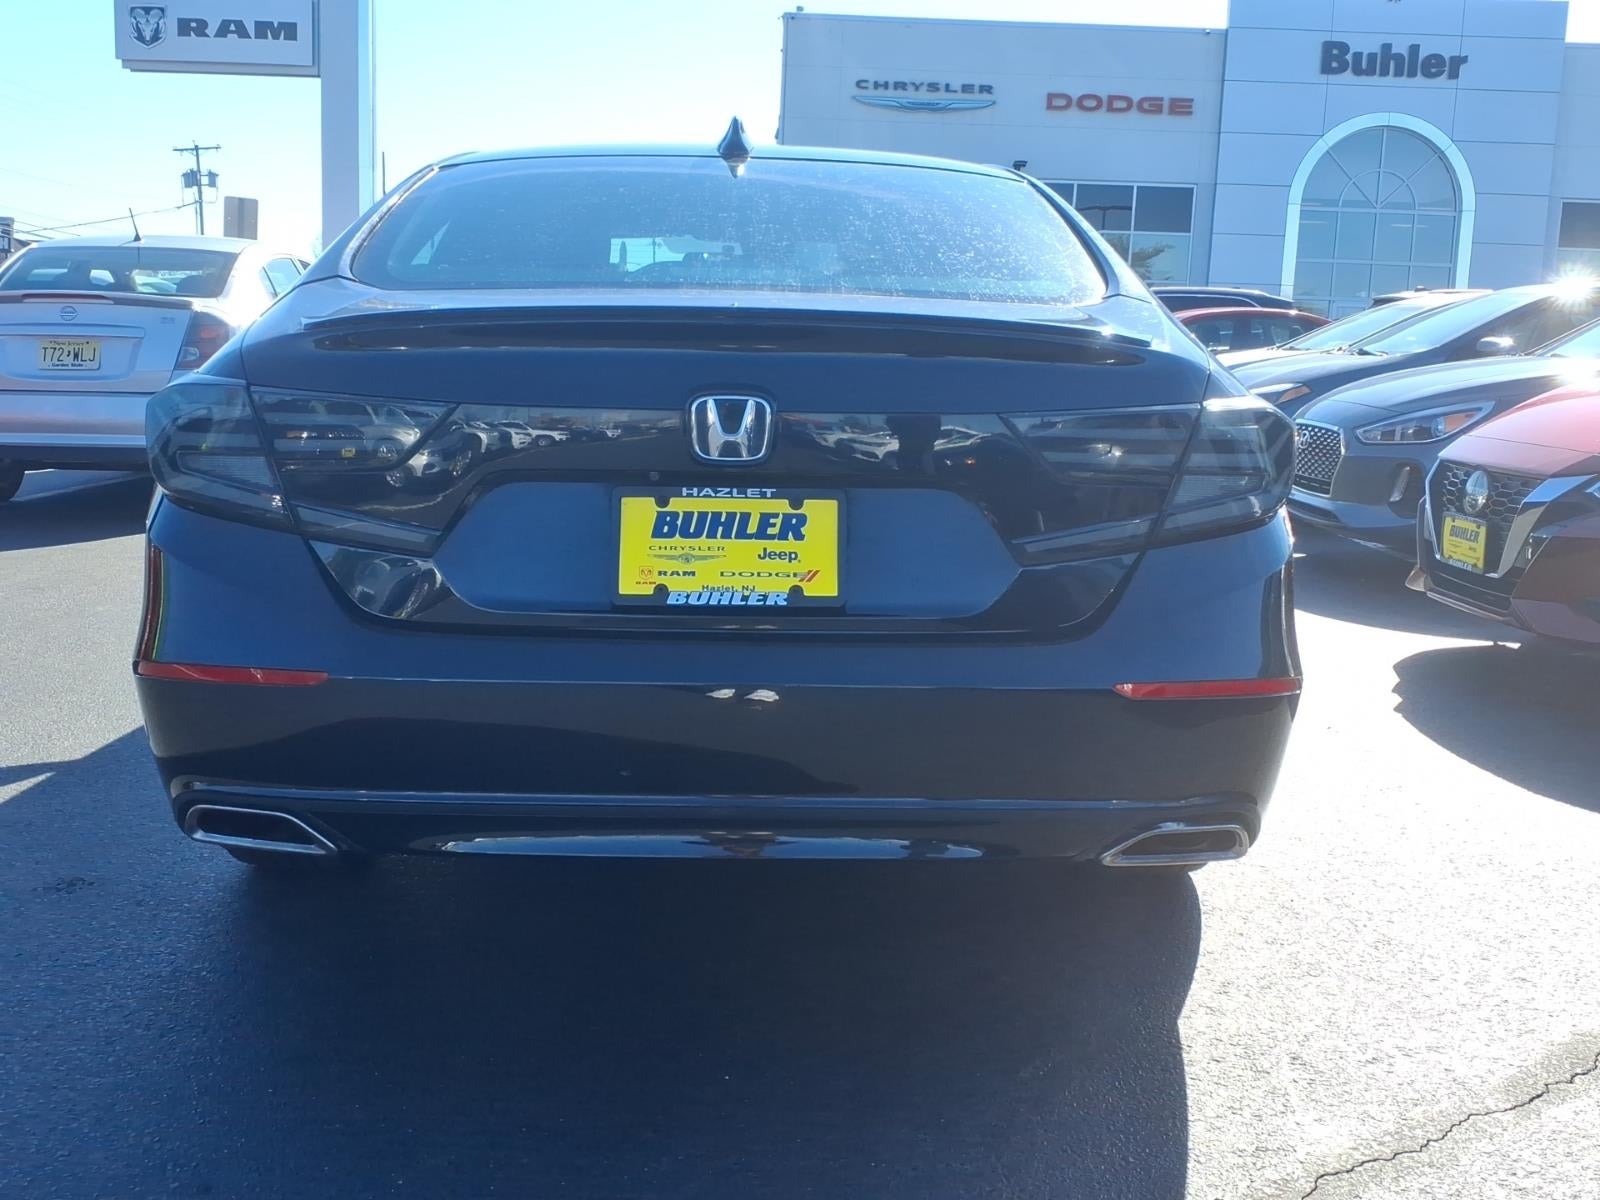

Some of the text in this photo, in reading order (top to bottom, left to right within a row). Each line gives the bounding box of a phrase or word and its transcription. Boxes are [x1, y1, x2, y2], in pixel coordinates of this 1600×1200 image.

[176, 17, 298, 42] RAM
[1320, 40, 1469, 80] Buhler
[855, 79, 994, 95] CHRYSLER
[1045, 92, 1195, 117] DODGE
[682, 487, 776, 497] HAZLET
[651, 511, 808, 541] BUHLER
[1449, 524, 1480, 544] BUHLER
[666, 591, 788, 606] BUHLER
